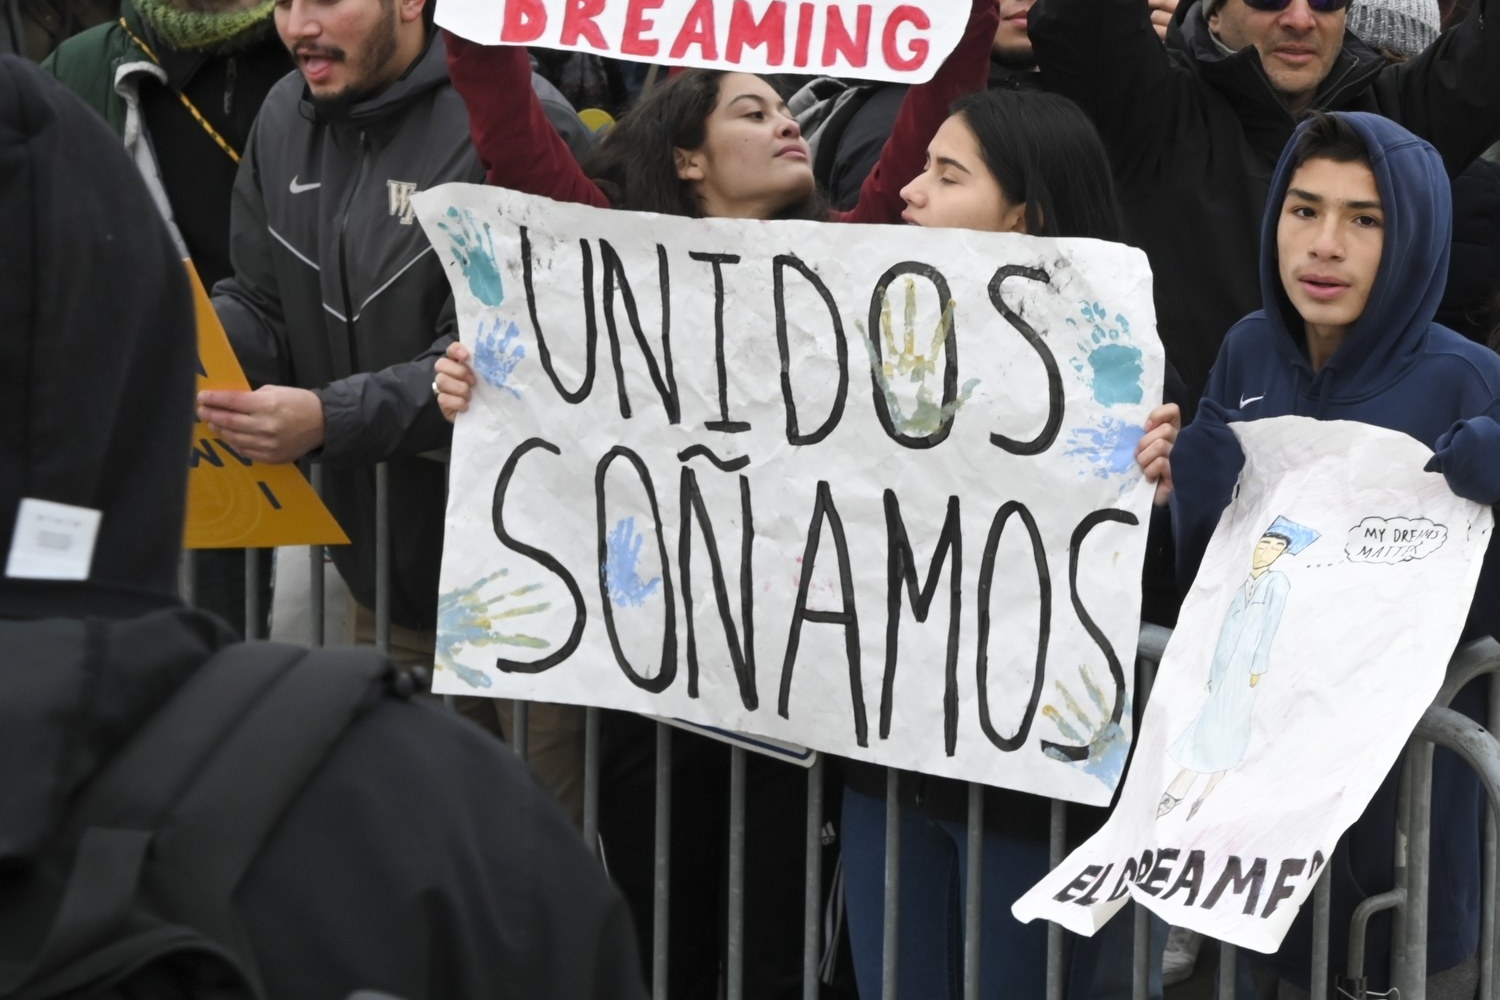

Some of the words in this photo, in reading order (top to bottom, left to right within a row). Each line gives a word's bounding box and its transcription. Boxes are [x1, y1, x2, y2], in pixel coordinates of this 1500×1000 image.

[519, 225, 1065, 456] UNIDOS
[491, 437, 1140, 763] SOÑAMOS
[1364, 527, 1386, 542] MY
[1053, 862, 1114, 906] EL
